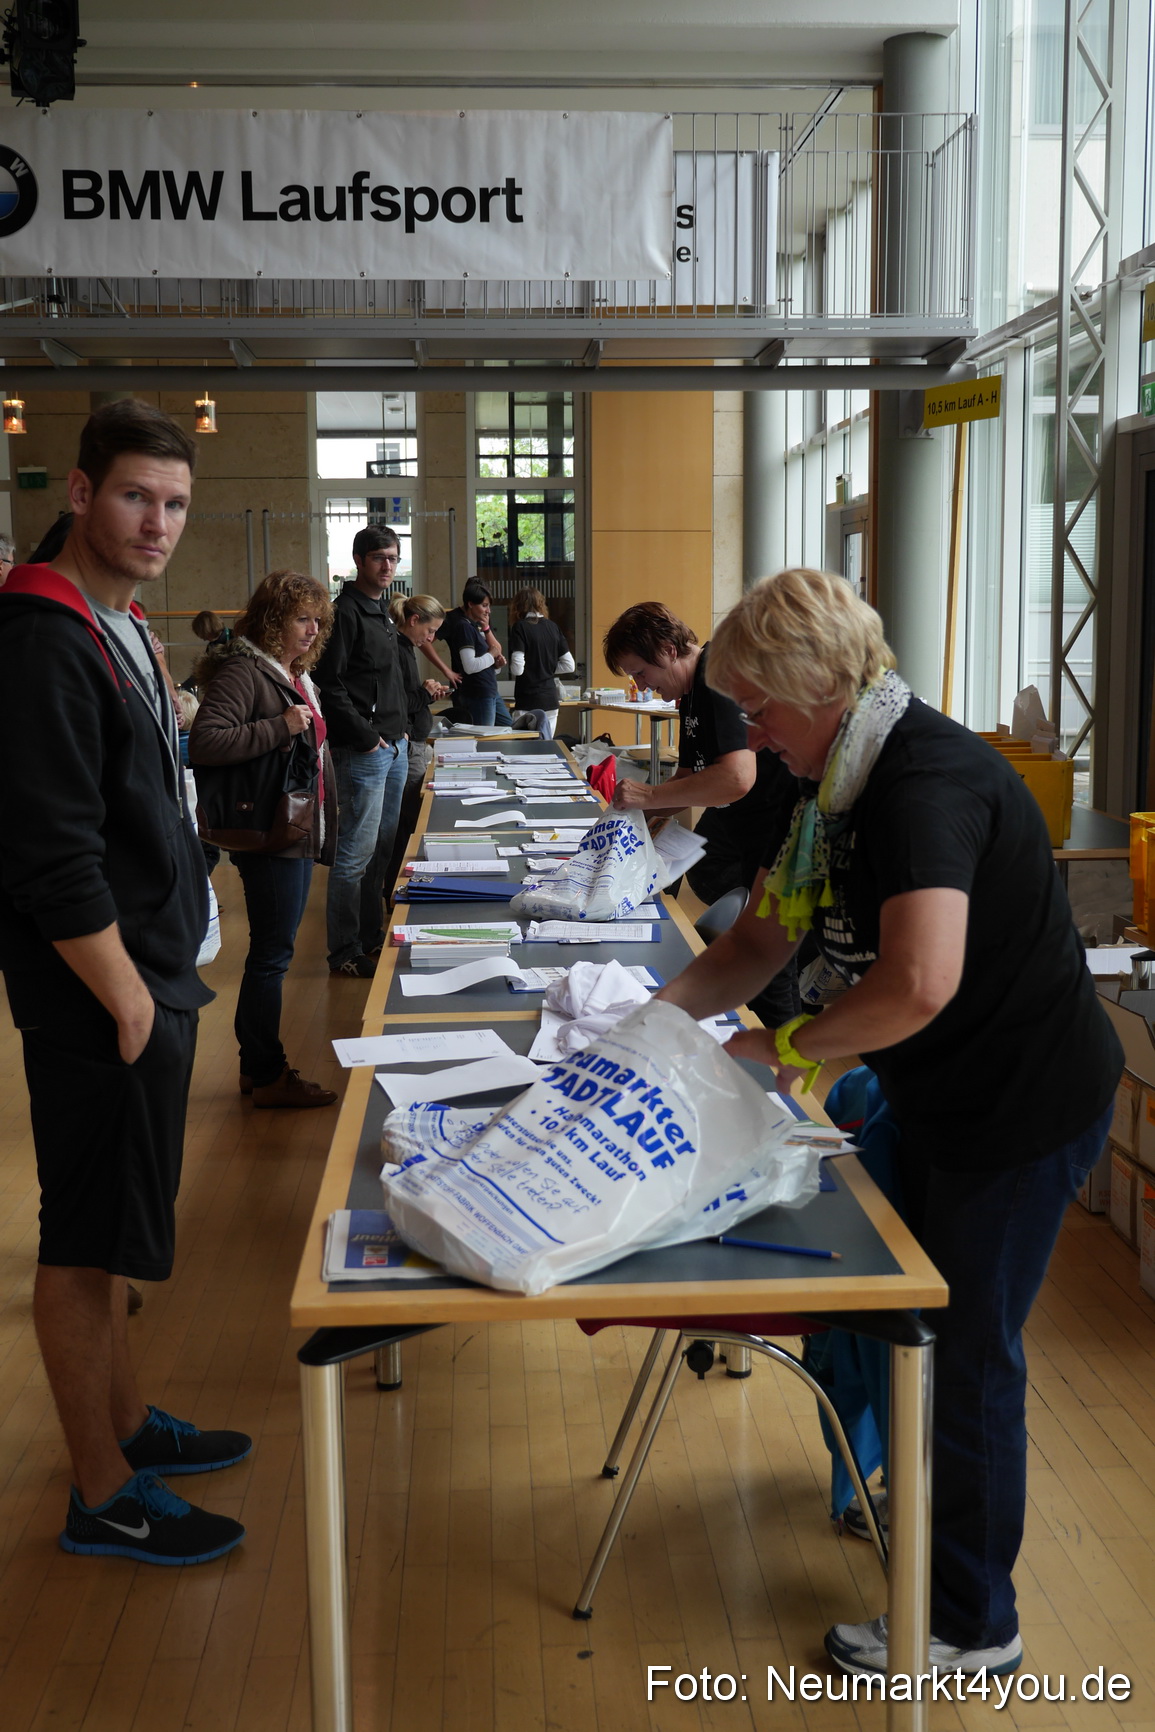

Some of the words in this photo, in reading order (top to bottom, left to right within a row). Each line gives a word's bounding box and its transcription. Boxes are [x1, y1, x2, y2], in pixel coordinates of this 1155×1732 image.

[62, 169, 224, 221] BMW
[240, 170, 524, 233] Laufsport
[927, 401, 943, 416] 10,5
[944, 400, 956, 412] km
[958, 393, 976, 410] Lauf
[977, 392, 984, 406] A
[990, 390, 998, 404] H
[541, 1066, 676, 1170] TADTLAUF
[564, 1050, 697, 1156] eumarkter
[544, 1156, 570, 1179] guten
[569, 1176, 602, 1206] Zweck!
[564, 1127, 589, 1153] km
[588, 1150, 627, 1183] Lauf
